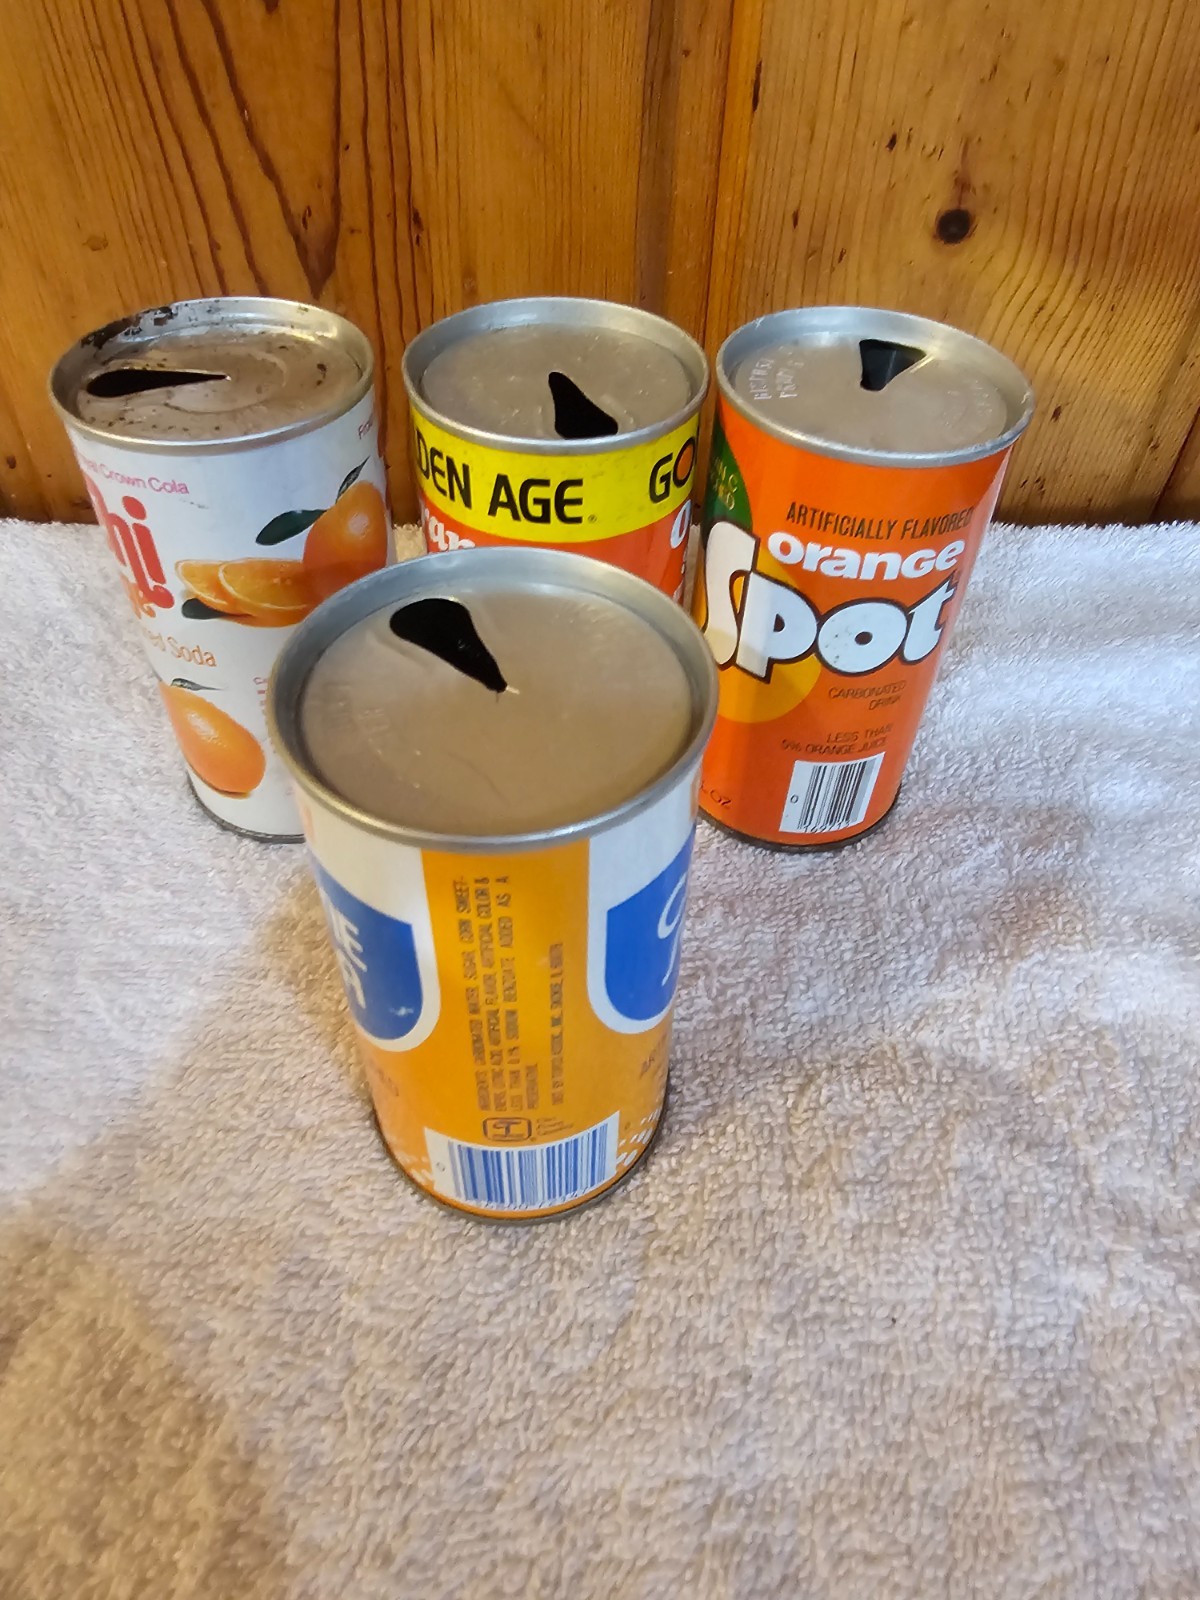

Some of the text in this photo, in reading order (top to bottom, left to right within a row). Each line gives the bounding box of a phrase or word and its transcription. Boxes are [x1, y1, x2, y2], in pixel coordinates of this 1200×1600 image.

[99, 463, 147, 489] Crown
[148, 477, 190, 495] Cola
[487, 472, 584, 525] AGE
[786, 501, 974, 541] ARTIFICIALLY FLAVORED
[767, 531, 966, 582] orange
[702, 521, 957, 684] Spot
[167, 636, 217, 667] Soda
[828, 680, 907, 700] CARBONATED
[826, 731, 860, 744] LESS
